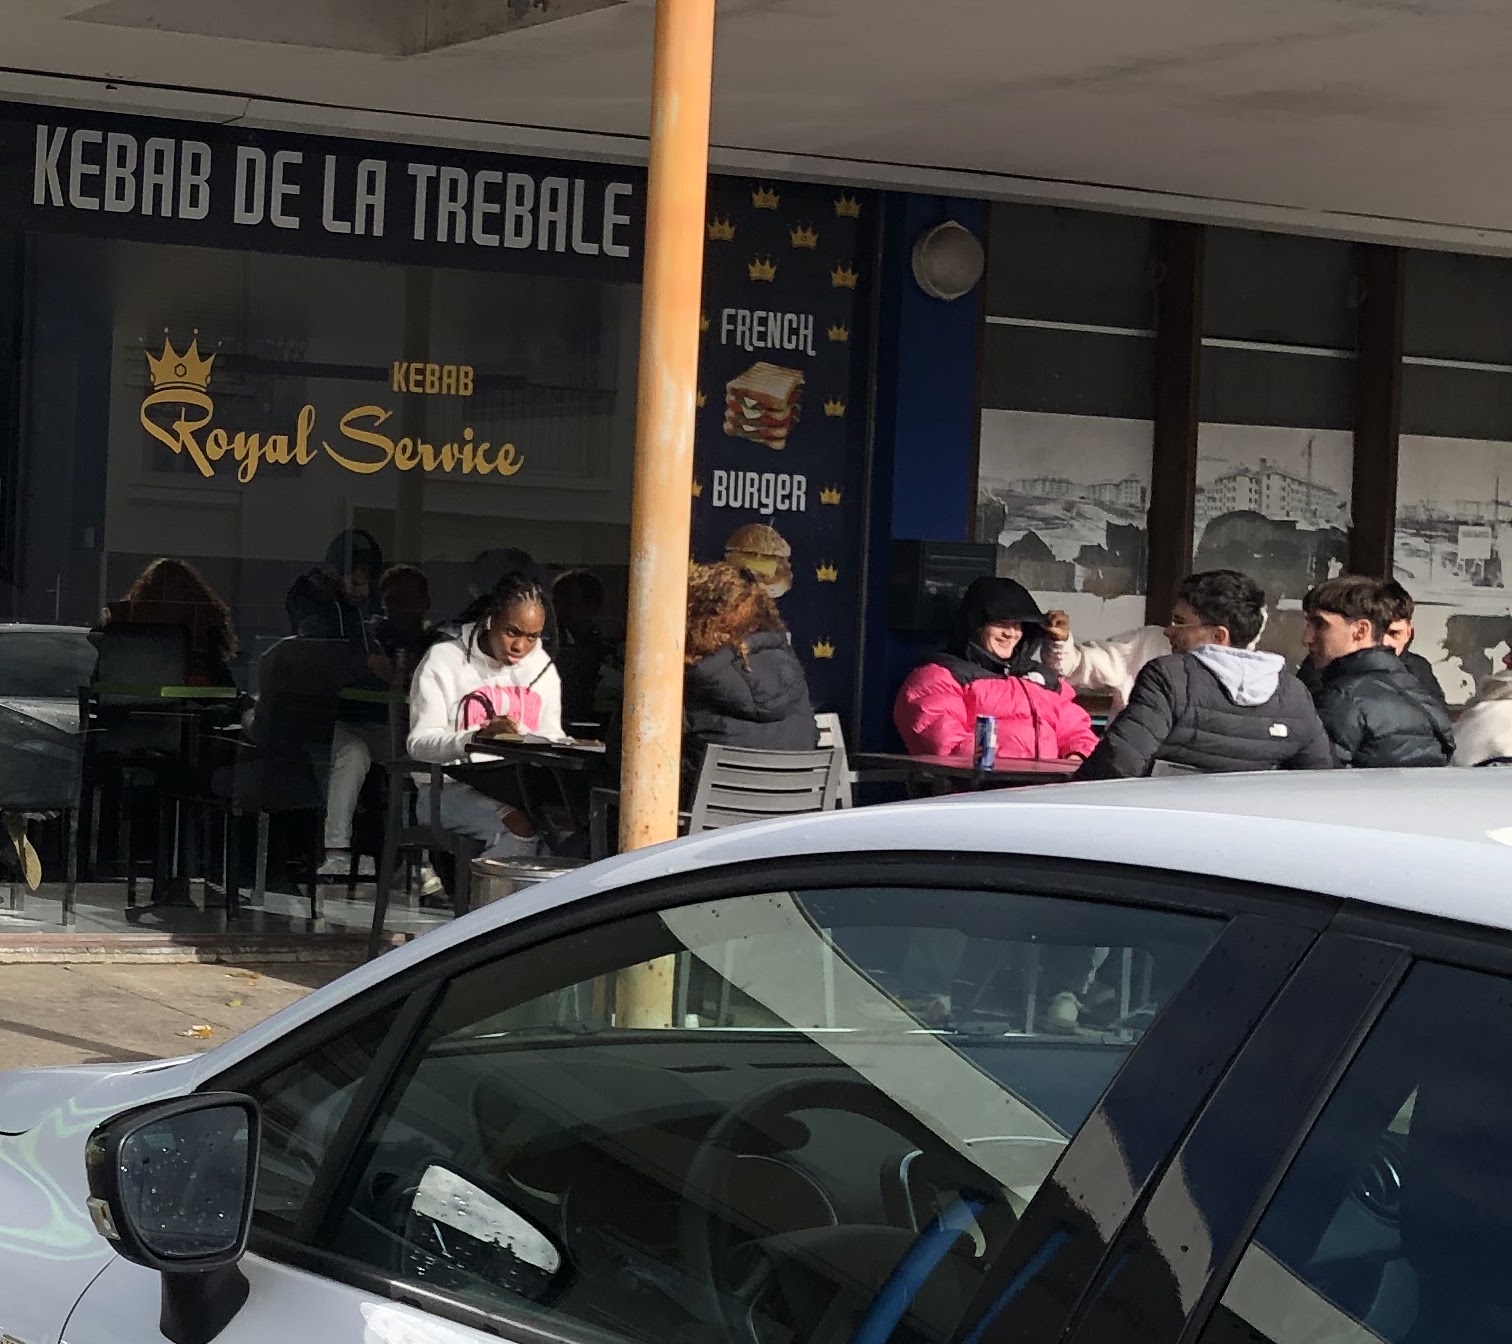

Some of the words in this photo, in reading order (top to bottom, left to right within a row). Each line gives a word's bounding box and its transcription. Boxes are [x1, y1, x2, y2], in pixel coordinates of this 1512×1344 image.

[33, 124, 213, 221] KEBAB
[233, 145, 303, 230] DE
[322, 154, 387, 238] LA
[407, 163, 633, 258] TREBALE
[720, 307, 817, 356] FRENCH
[392, 360, 475, 397] KEBAB
[140, 388, 319, 484] Royal
[322, 404, 525, 477] Service
